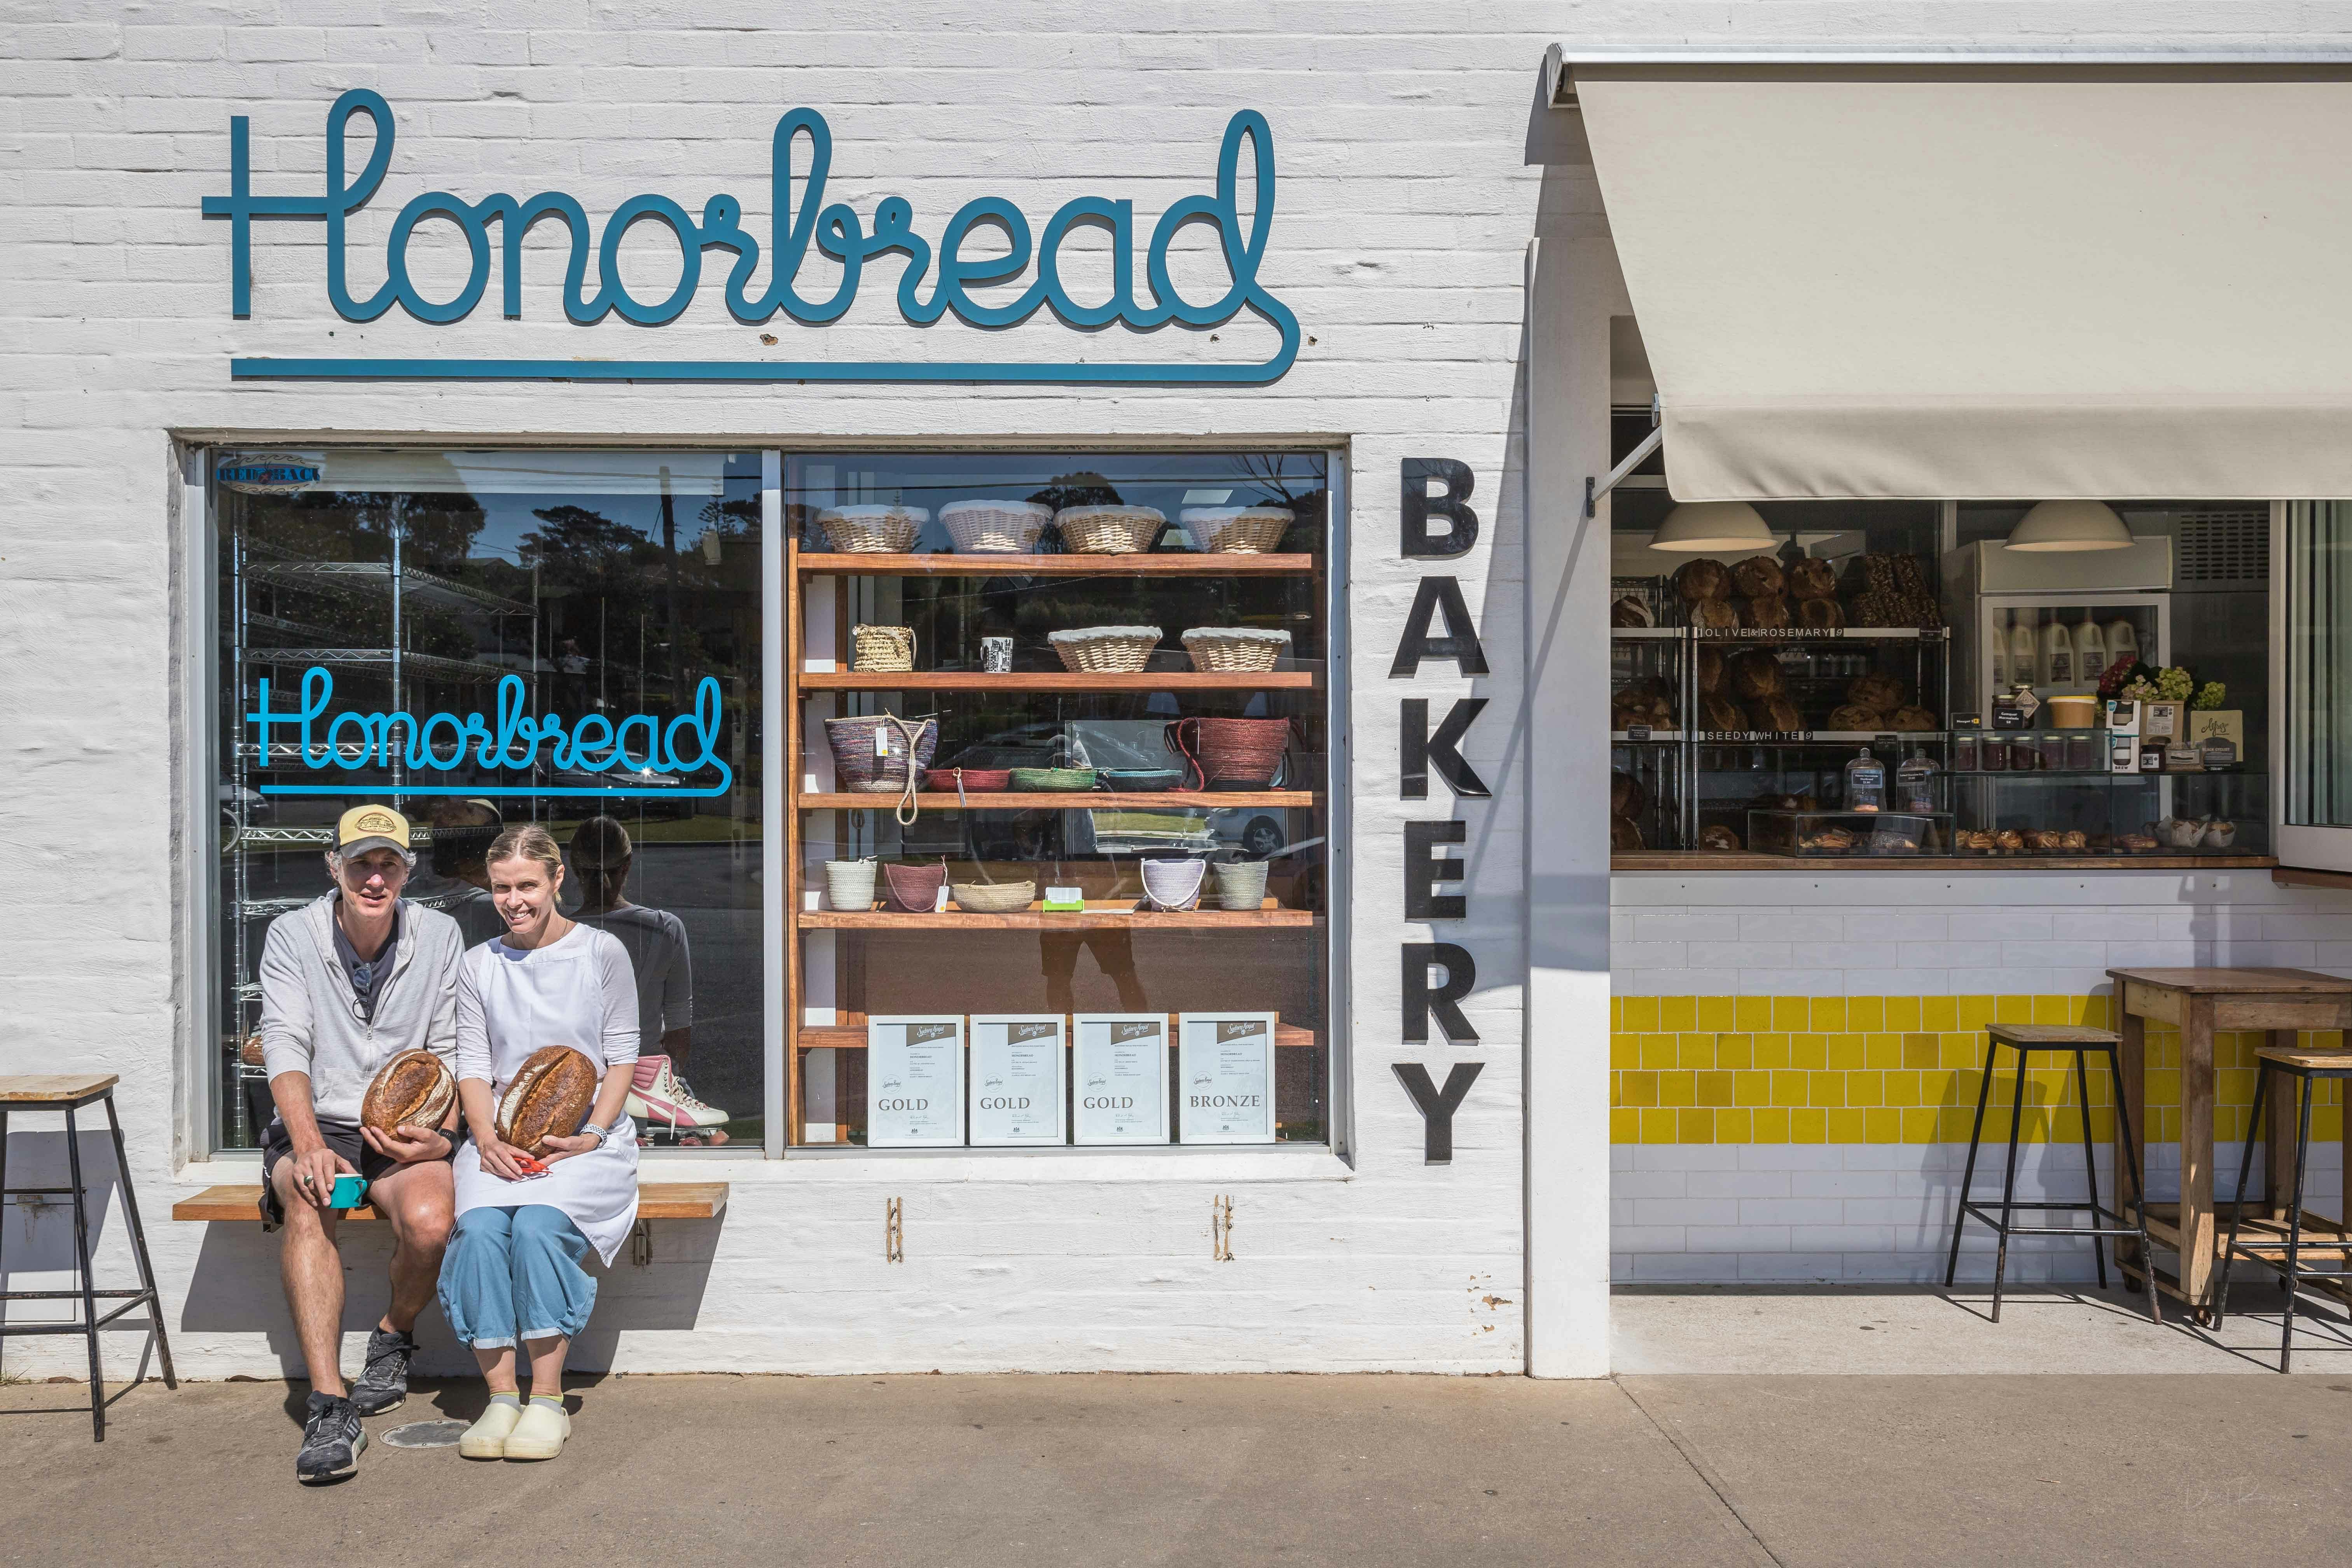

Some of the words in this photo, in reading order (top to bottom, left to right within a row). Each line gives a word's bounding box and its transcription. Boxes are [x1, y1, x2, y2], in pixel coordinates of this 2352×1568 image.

[201, 87, 1302, 384] Honorbread
[220, 468, 256, 481] RED
[1760, 628, 1829, 636] ROSEMARY
[246, 666, 732, 797] Honorbread
[1707, 731, 1749, 740] SEEDY
[1754, 731, 1798, 740] WHITE
[1388, 457, 1494, 1166] BAKERY
[878, 1099, 928, 1111] GOLD
[980, 1098, 1030, 1109] GOLD
[1083, 1097, 1133, 1109] GOLD
[1190, 1095, 1260, 1107] BRONZE
